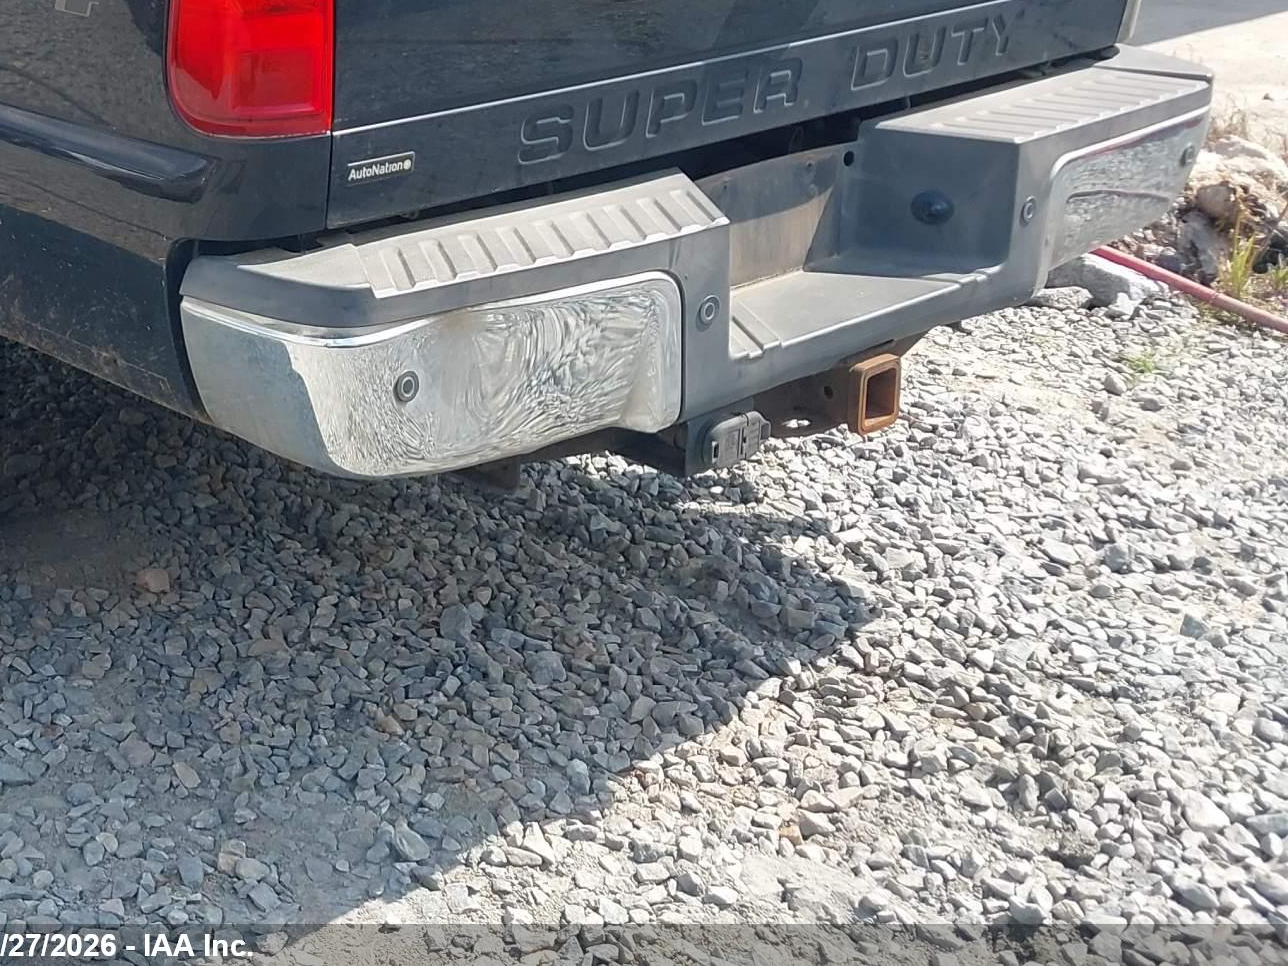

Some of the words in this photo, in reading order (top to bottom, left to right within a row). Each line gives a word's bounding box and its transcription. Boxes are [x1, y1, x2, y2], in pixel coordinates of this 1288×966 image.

[517, 56, 803, 166] SUPER
[850, 13, 1011, 92] DUTY
[347, 161, 404, 182] AutoNation
